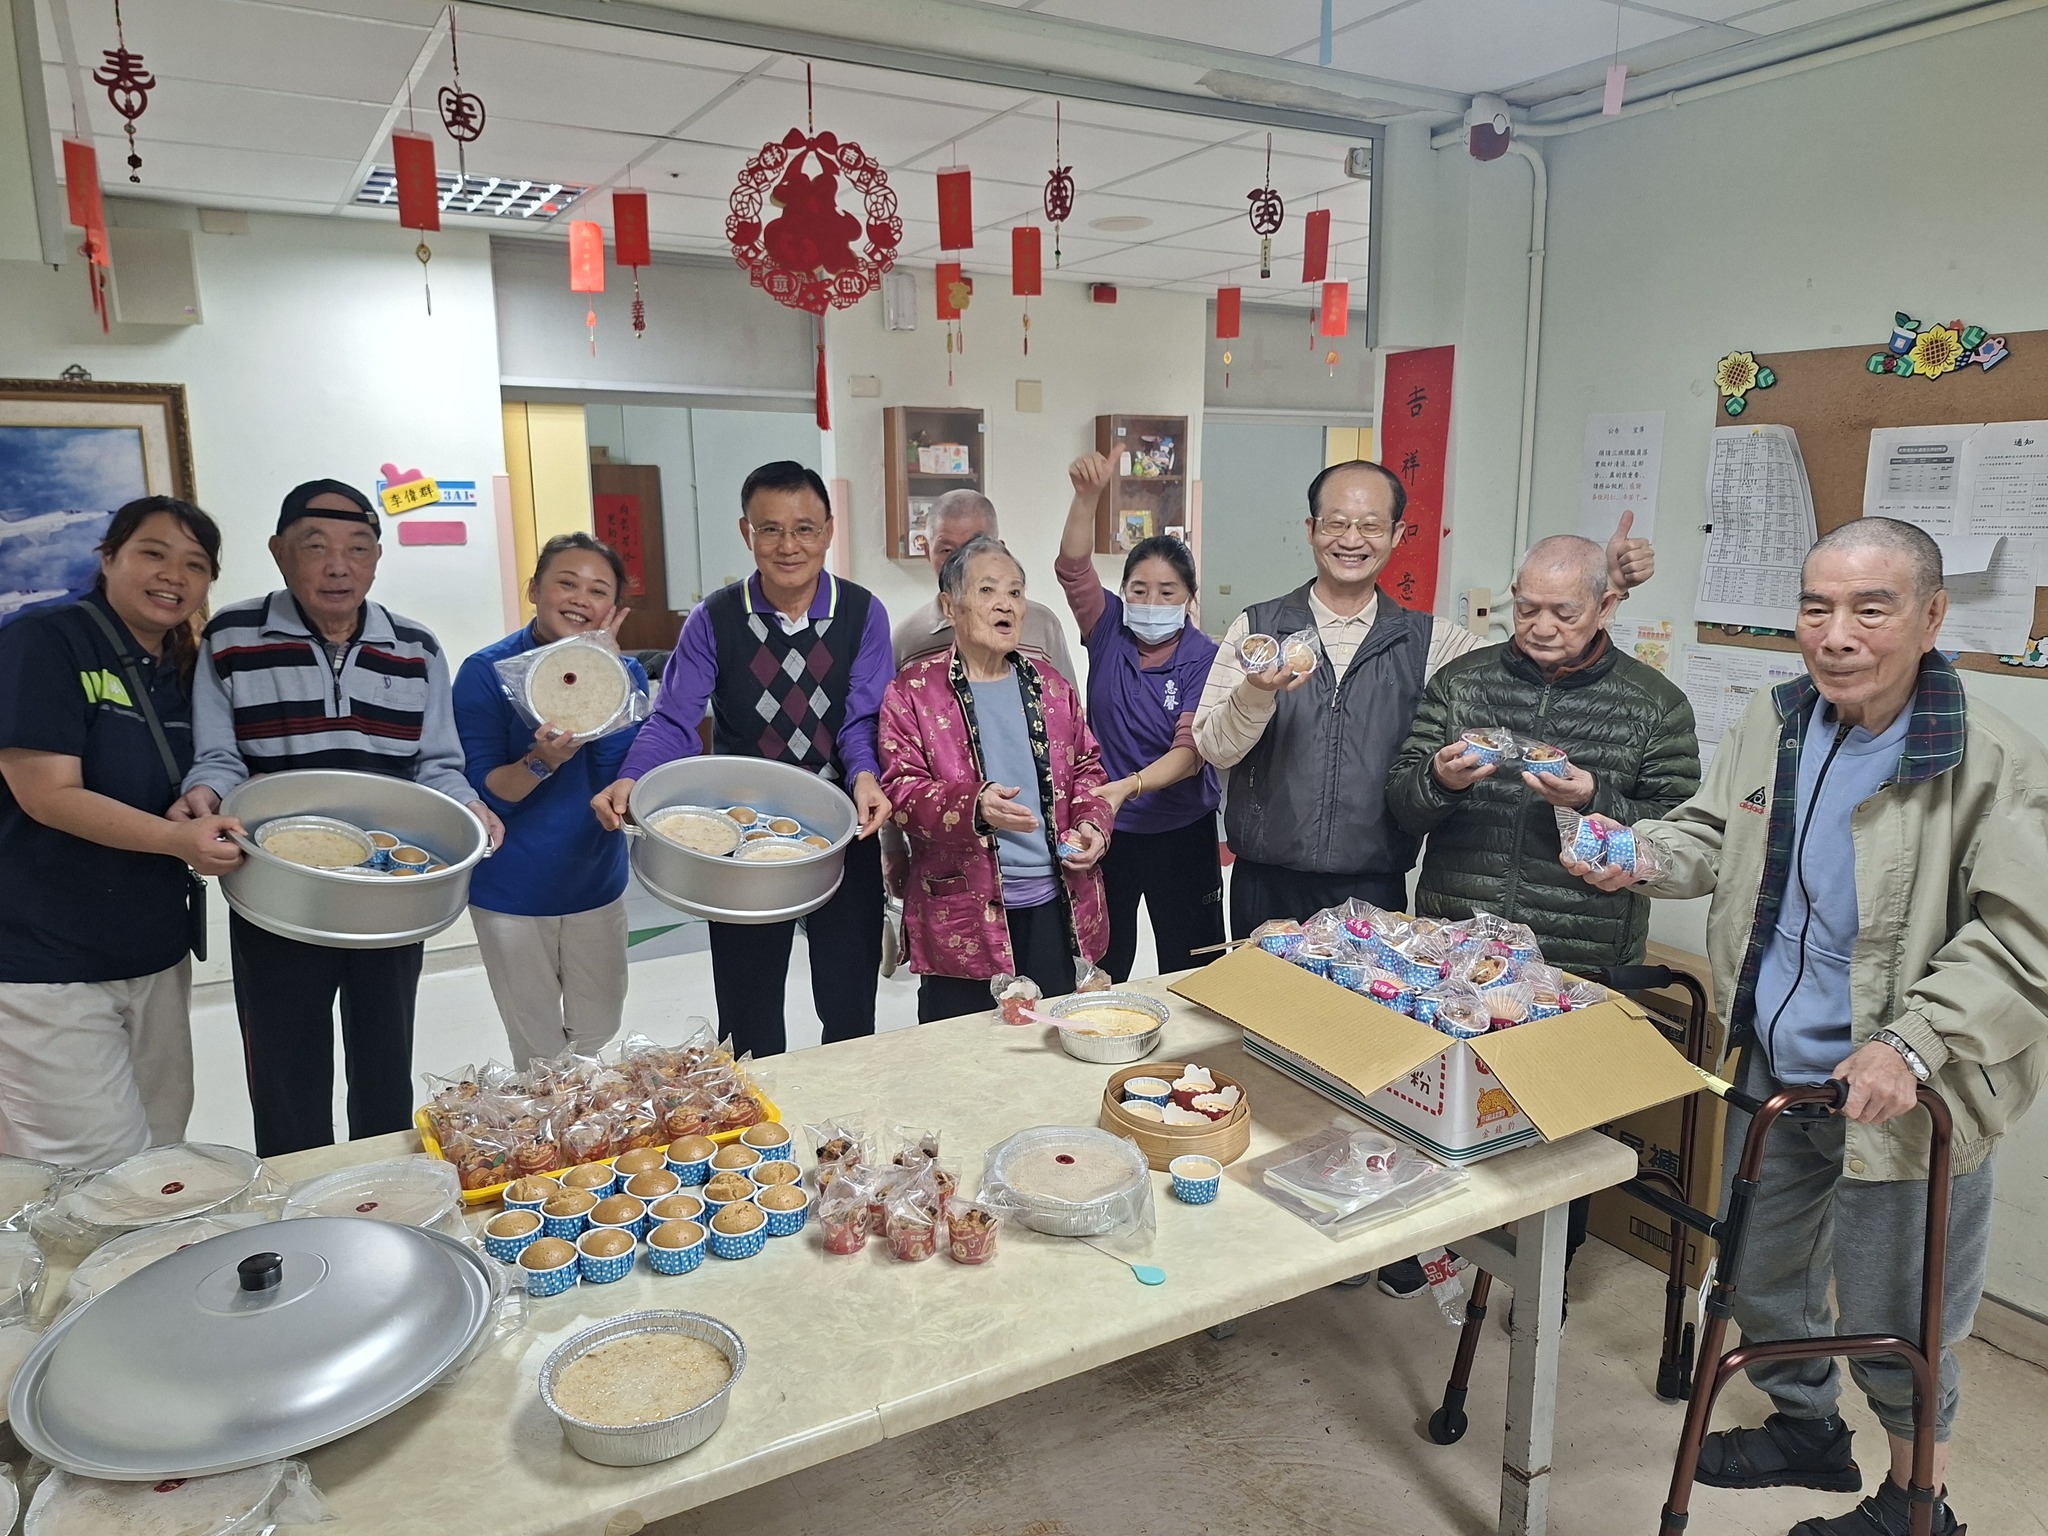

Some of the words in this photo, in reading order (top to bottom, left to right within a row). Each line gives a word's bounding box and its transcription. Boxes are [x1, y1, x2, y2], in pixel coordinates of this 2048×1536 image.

[2013, 438, 2035, 447] 通知
[390, 484, 434, 508] 李偉群
[1410, 1071, 1432, 1095] 粉
